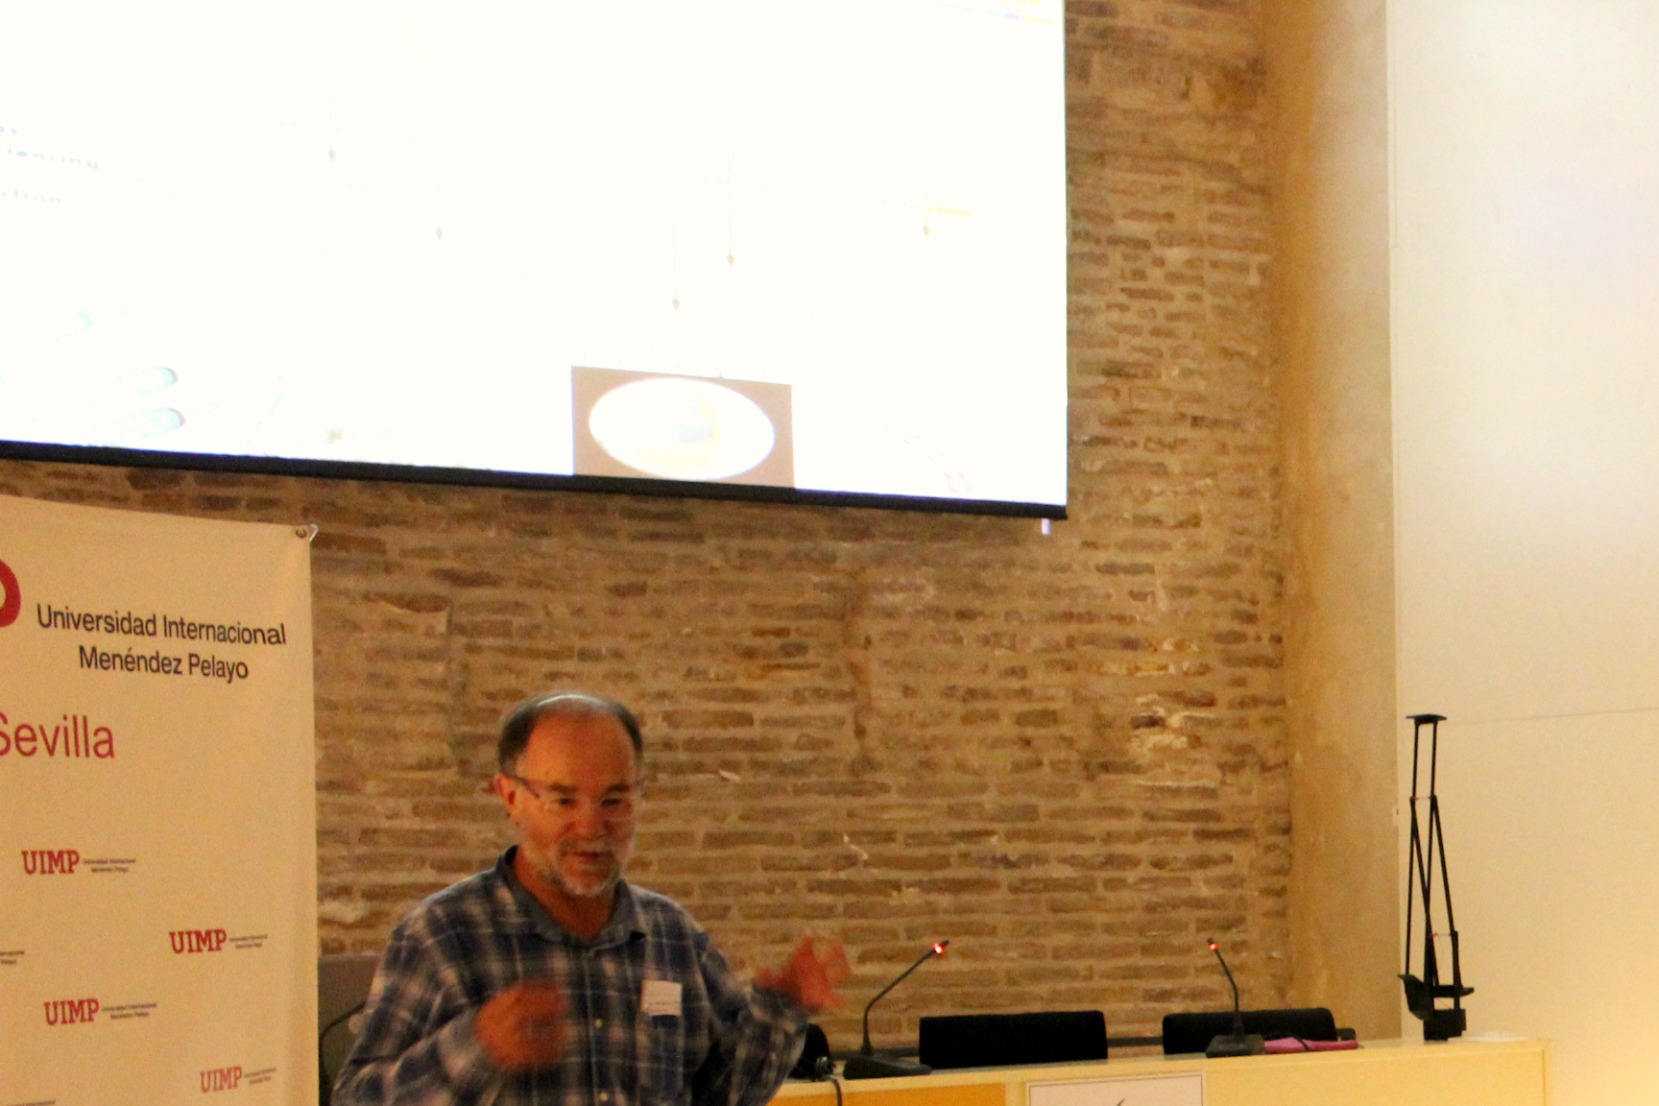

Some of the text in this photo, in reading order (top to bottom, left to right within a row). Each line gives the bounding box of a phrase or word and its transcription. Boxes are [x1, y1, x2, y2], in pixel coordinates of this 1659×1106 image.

[37, 603, 287, 645] Universidad Internacional
[79, 645, 249, 684] Menéndez Pelayo
[21, 849, 80, 875] UIMP
[168, 928, 227, 955] UIMP
[44, 998, 100, 1025] UIMP
[200, 1065, 243, 1093] UIMP
